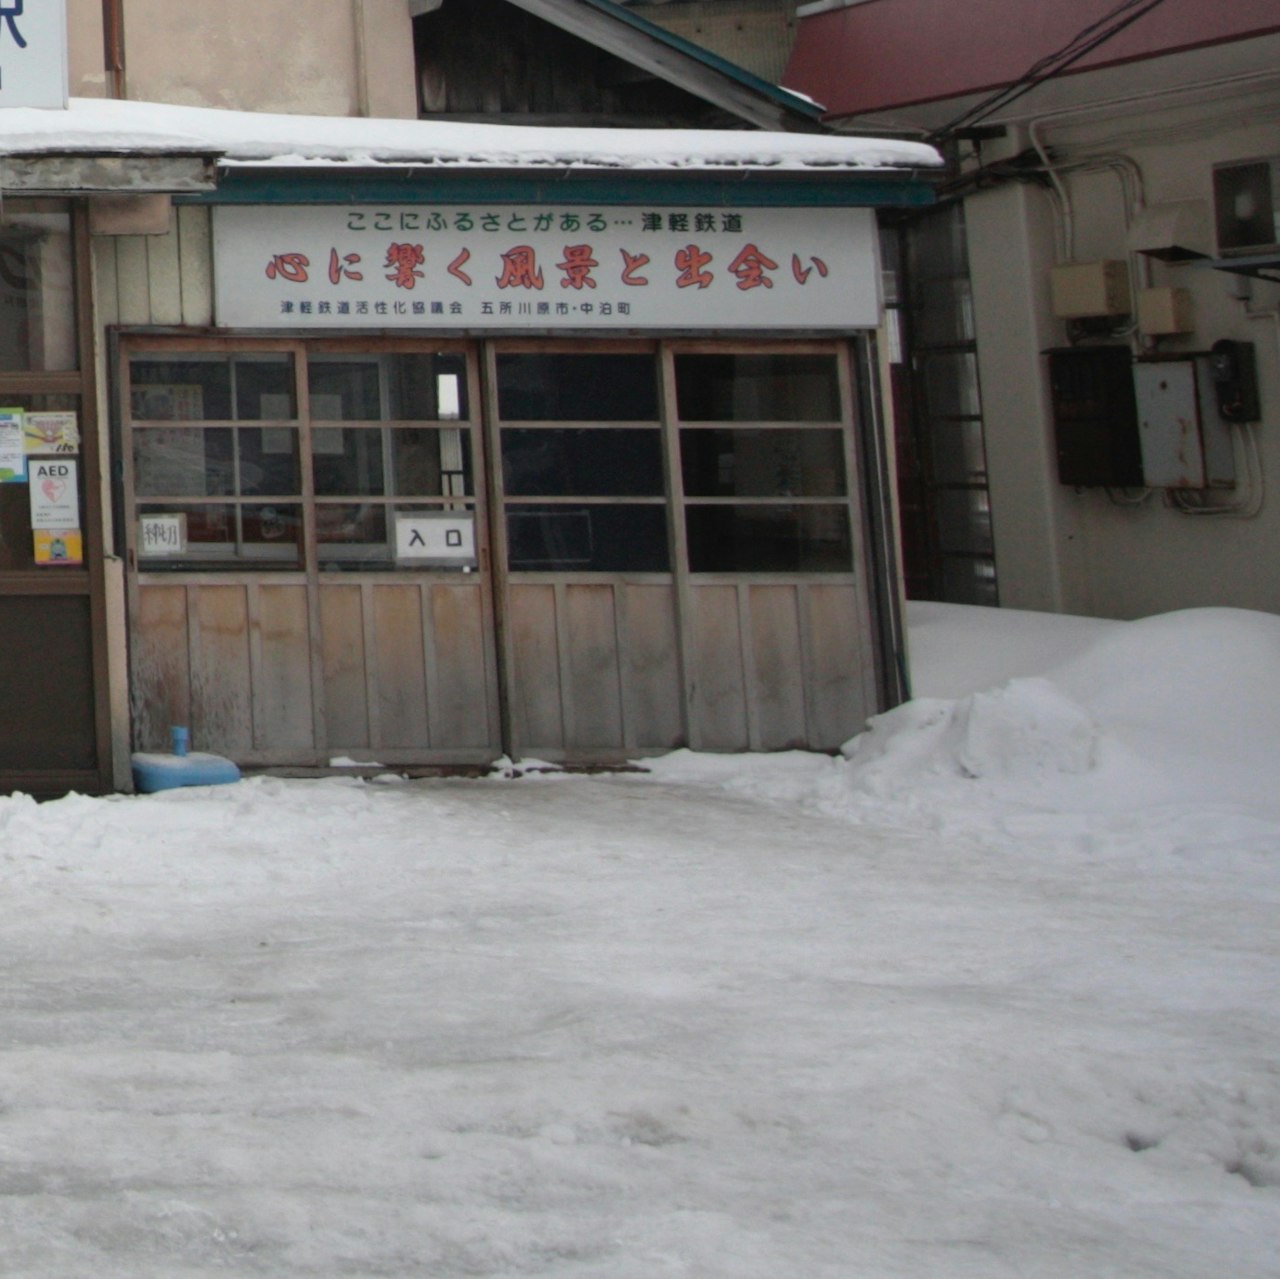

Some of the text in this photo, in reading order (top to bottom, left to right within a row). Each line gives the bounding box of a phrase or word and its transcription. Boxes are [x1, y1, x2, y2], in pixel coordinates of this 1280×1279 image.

[265, 241, 831, 291] 心に響く風景と出会い
[280, 300, 464, 316] 津軽鉄道活性化協議会
[37, 465, 69, 477] AED
[407, 527, 463, 548] 入口
